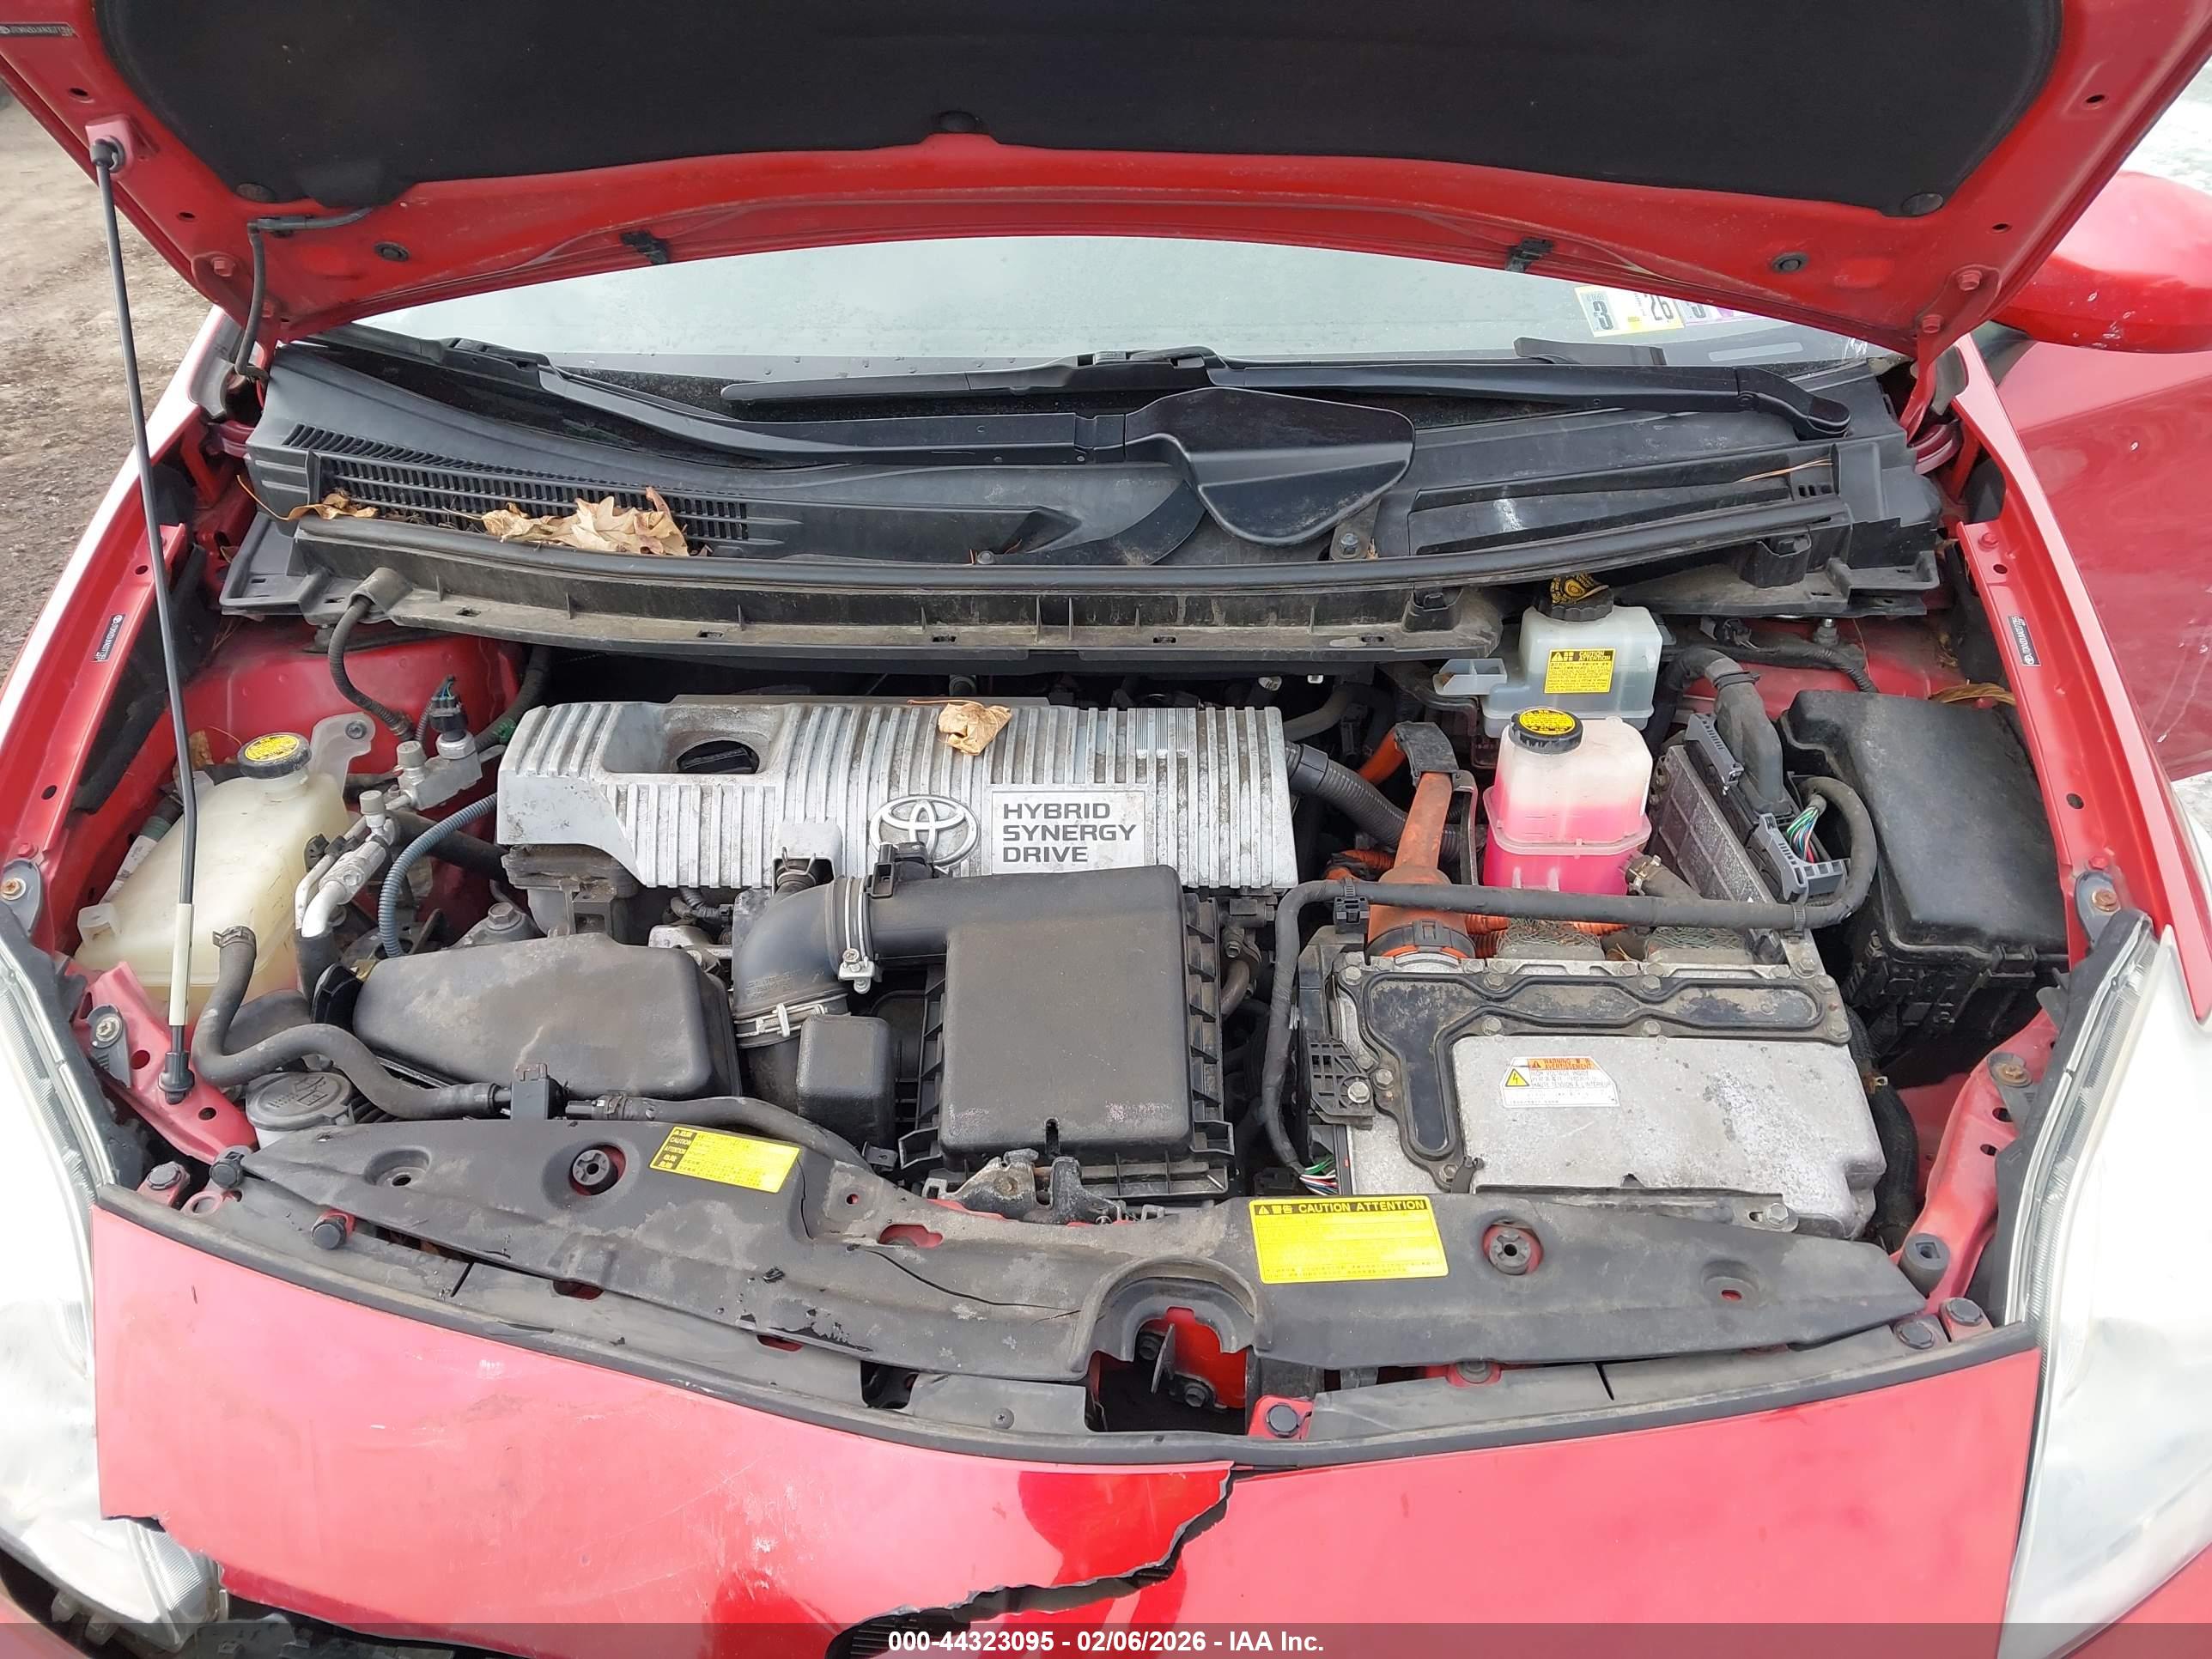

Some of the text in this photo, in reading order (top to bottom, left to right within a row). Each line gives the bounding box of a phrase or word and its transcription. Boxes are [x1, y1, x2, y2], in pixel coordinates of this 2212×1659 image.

[1592, 301, 1614, 331] 3
[1003, 803, 1110, 819] HYBRID
[1003, 824, 1137, 842] SYNERGY
[1003, 846, 1088, 863] DRIVE
[670, 1136, 691, 1146] CAUTION
[1298, 1200, 1425, 1213] CAUTION ATTENTION
